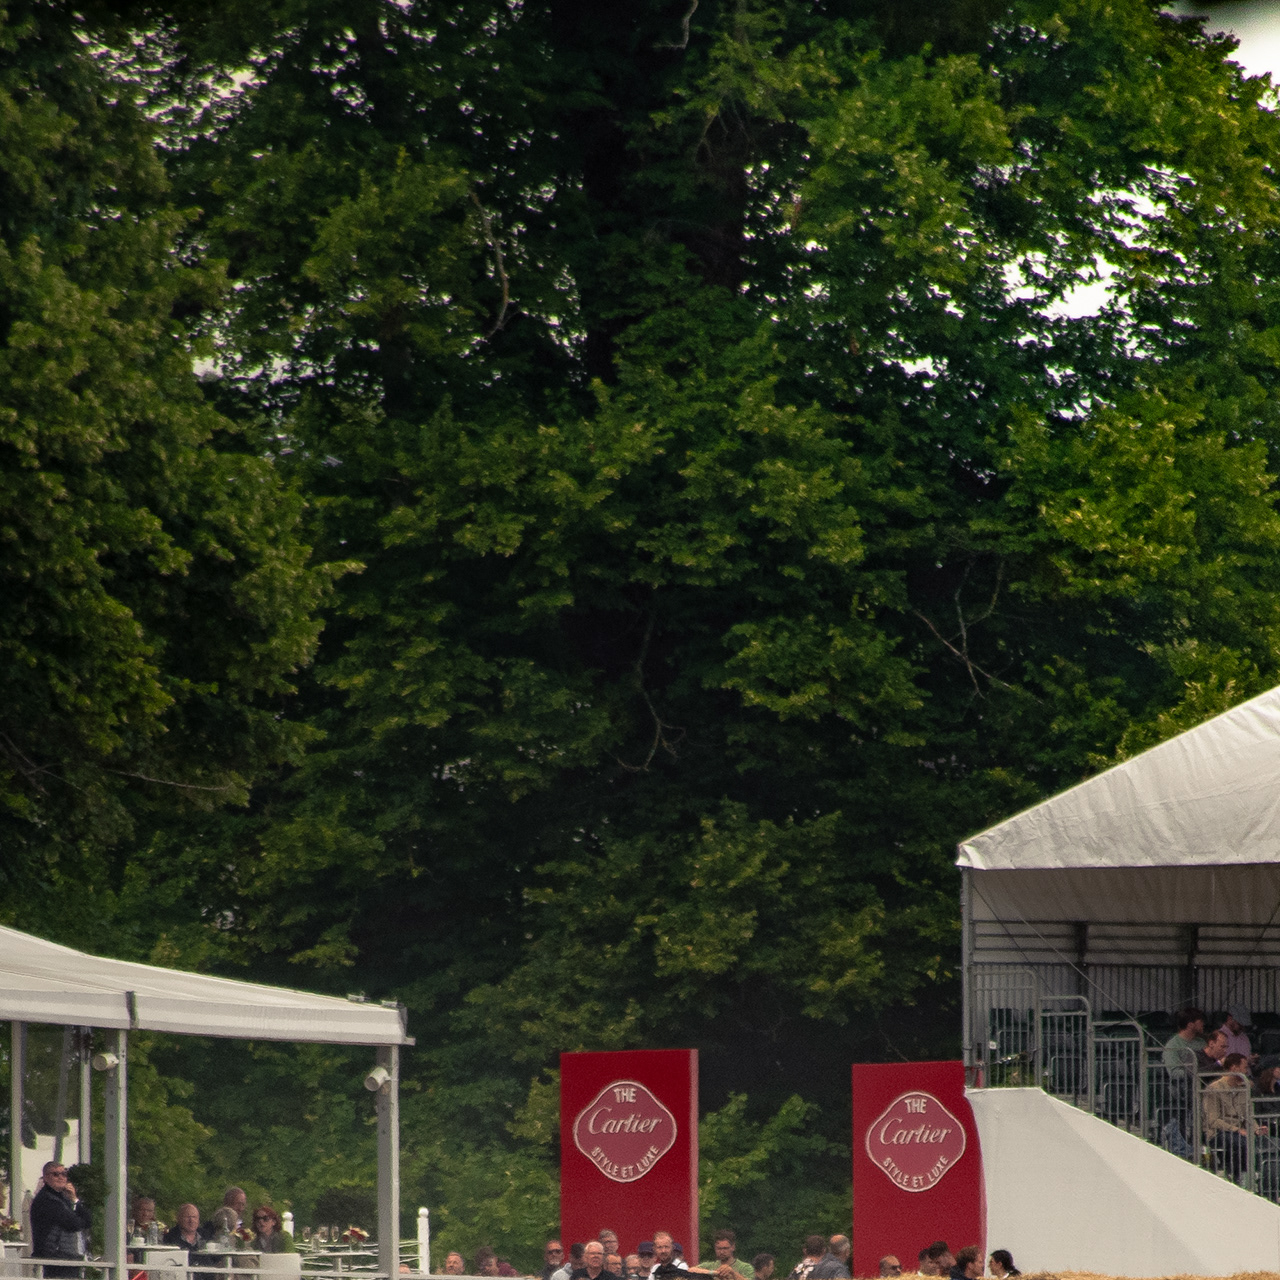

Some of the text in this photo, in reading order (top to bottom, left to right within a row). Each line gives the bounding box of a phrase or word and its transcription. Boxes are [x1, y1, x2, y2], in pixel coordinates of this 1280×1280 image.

[613, 1088, 637, 1103] THE
[905, 1099, 927, 1114] THE
[588, 1107, 662, 1134] Cartier
[880, 1118, 951, 1145] Cartier
[591, 1145, 659, 1178] STYLE ET LUXE
[883, 1155, 949, 1188] STYLE ET LUXE
